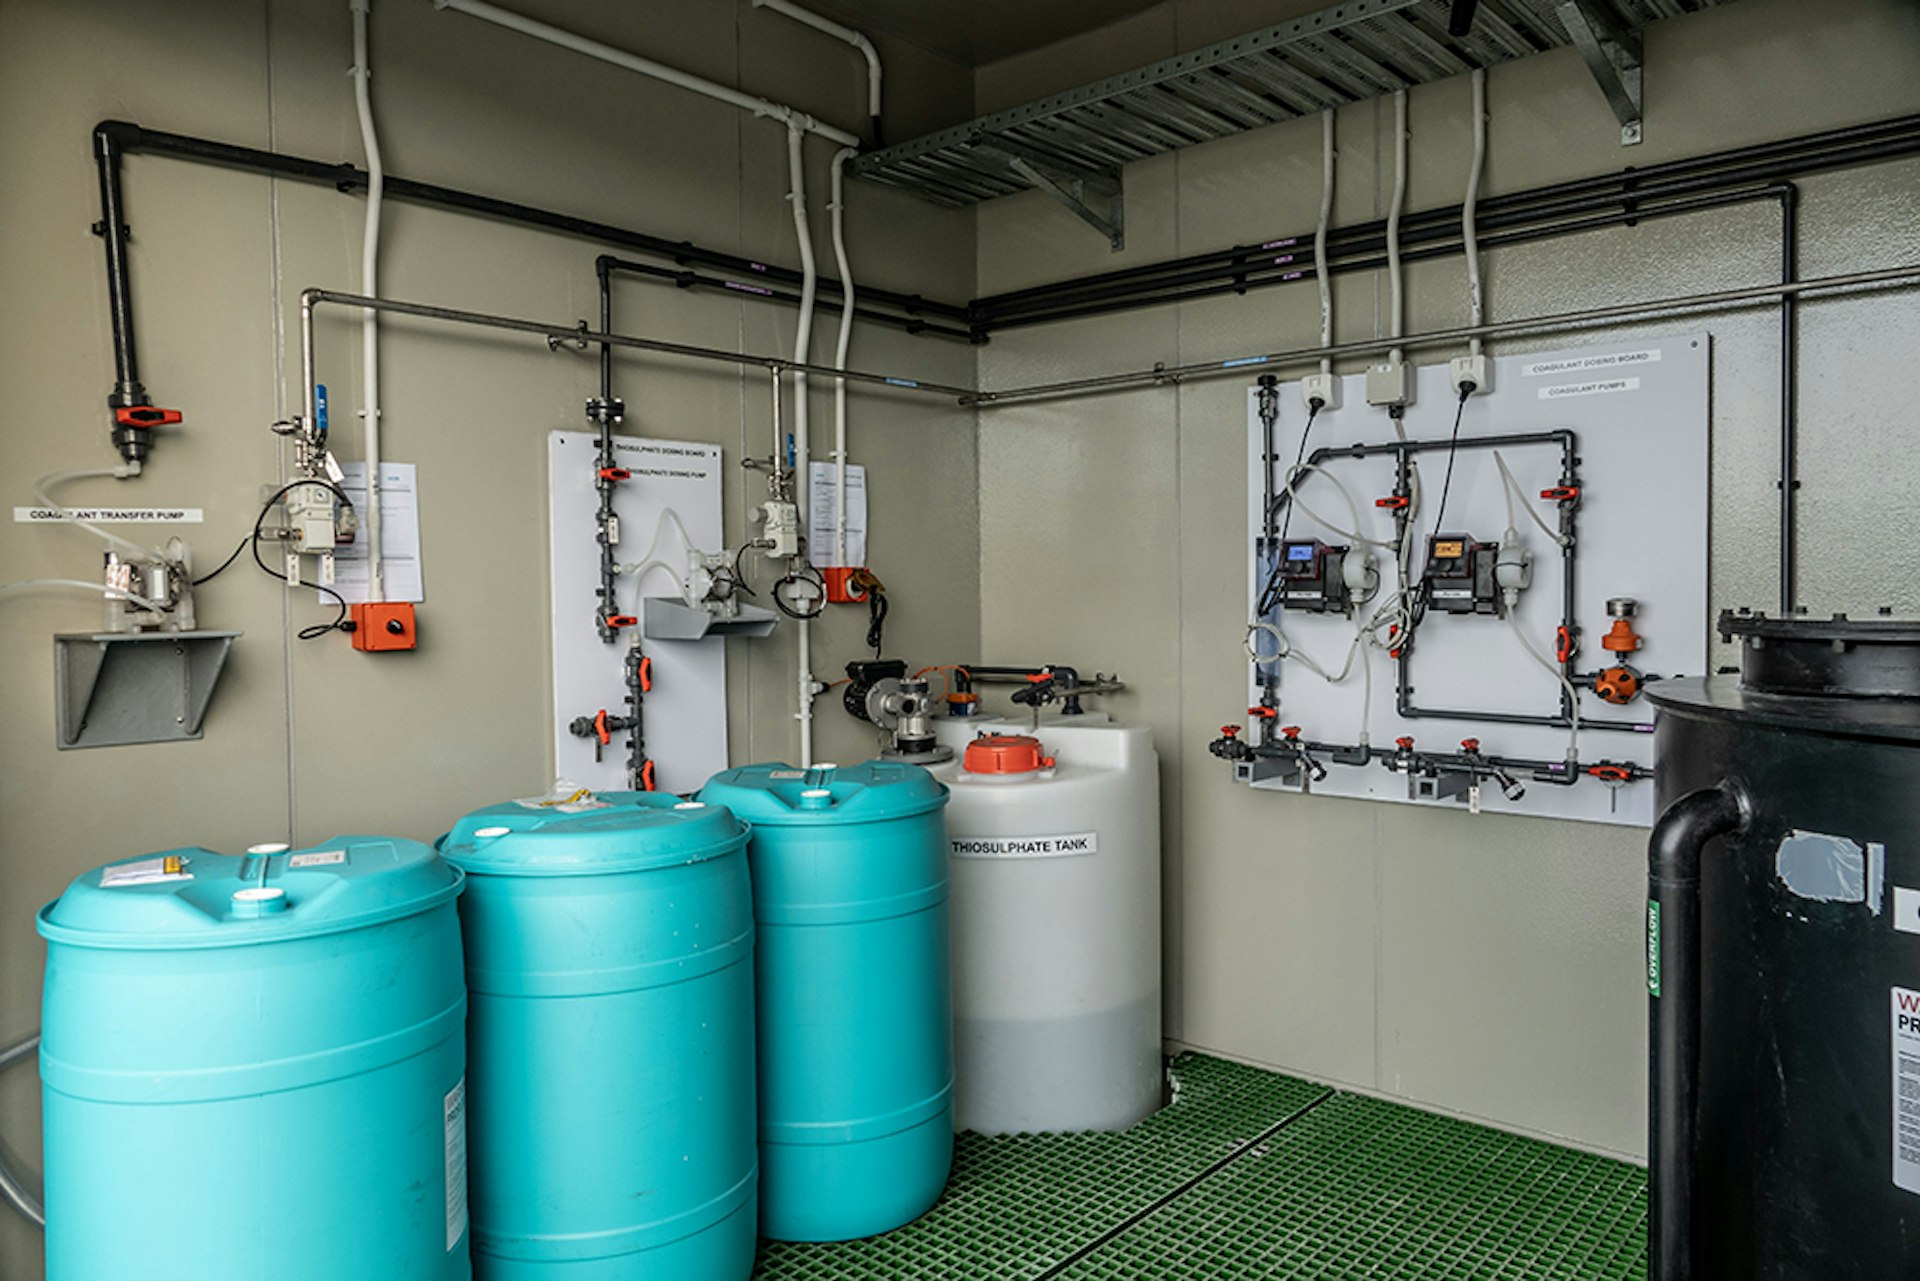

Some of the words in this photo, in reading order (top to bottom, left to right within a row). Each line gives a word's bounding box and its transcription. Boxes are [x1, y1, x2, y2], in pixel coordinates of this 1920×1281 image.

[1618, 352, 1649, 362] BOARD
[1598, 381, 1626, 390] PUMPS
[30, 510, 97, 519] COAGANT
[101, 511, 154, 519] TRANSFER
[952, 841, 1051, 854] THIOSULPHATE
[1055, 838, 1088, 850] TANK
[1648, 907, 1658, 979] OVERFLOW
